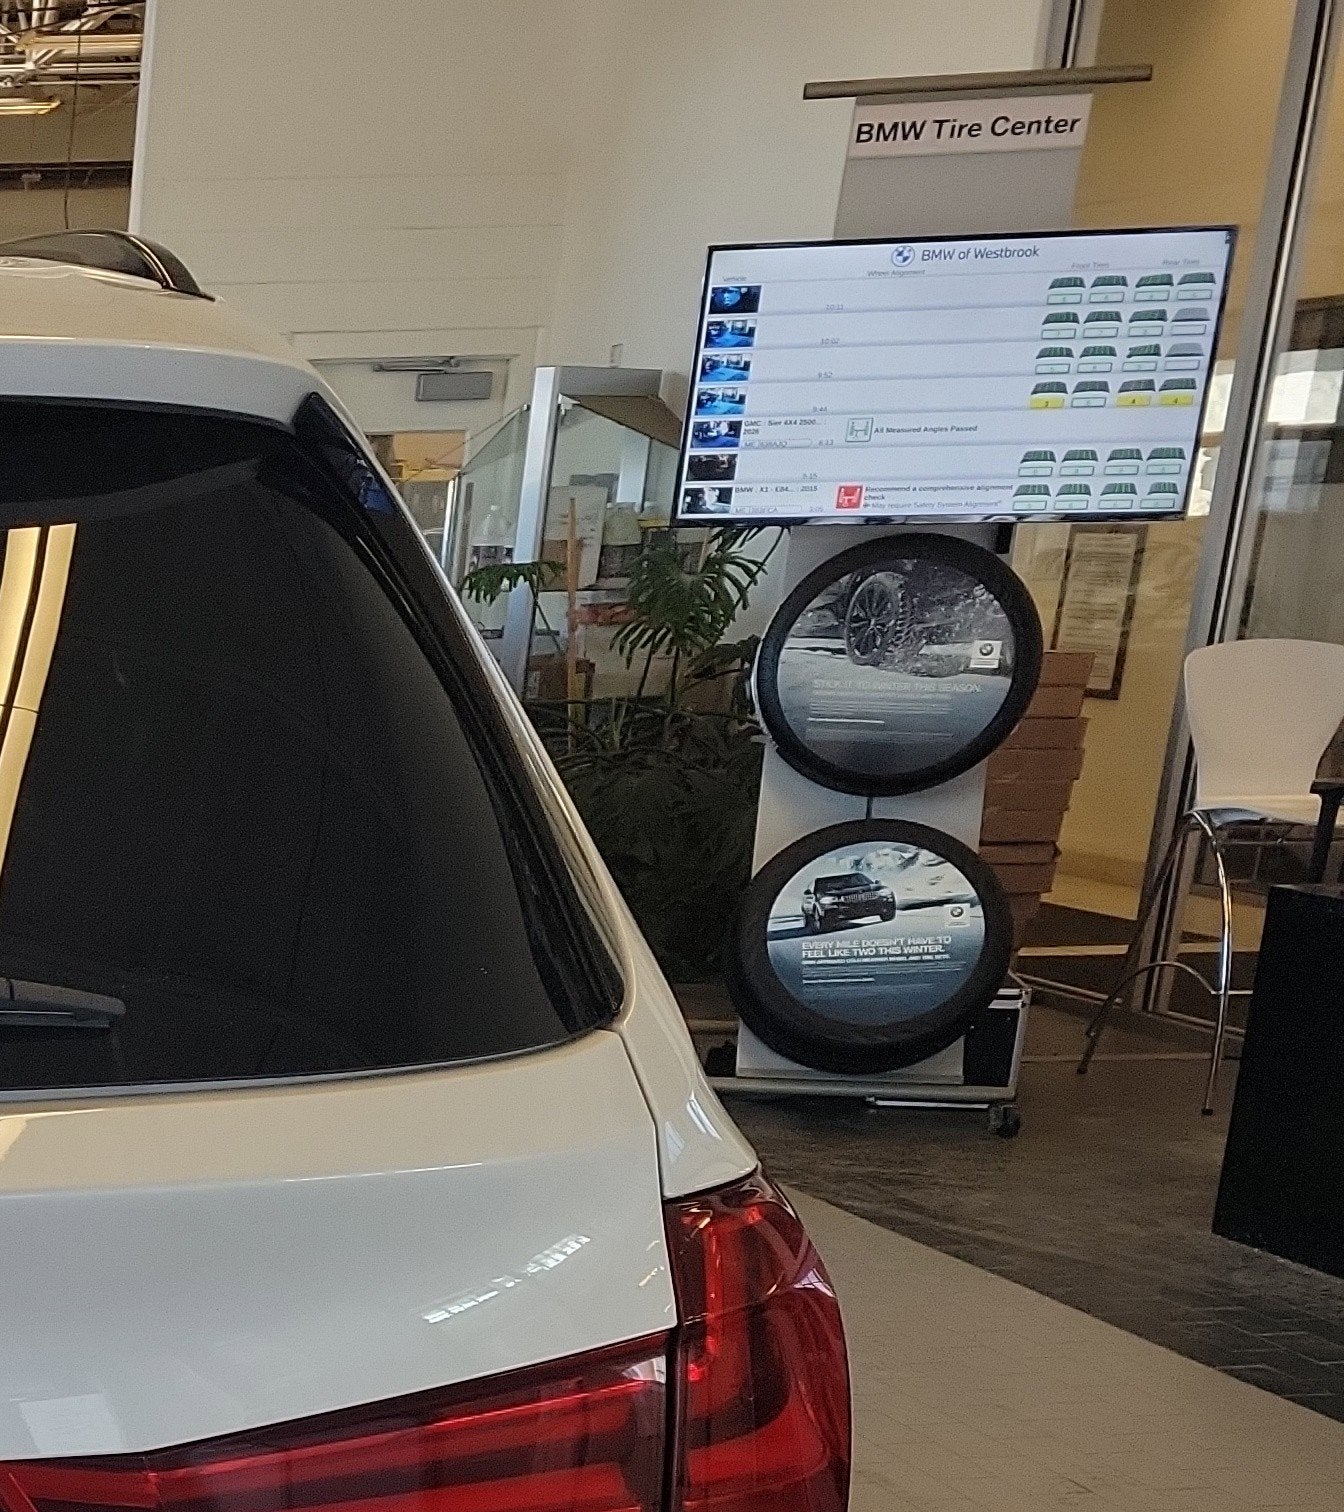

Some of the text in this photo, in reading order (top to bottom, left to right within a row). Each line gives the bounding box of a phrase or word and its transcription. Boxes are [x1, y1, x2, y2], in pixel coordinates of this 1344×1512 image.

[855, 115, 1082, 144] BMW Tire Center
[921, 245, 1040, 262] BMW of Westbrook
[886, 426, 922, 434] Measured
[923, 425, 949, 434] Angles
[950, 425, 978, 433] Passed
[918, 484, 975, 493] comprehensive
[976, 484, 1013, 493] alignment
[802, 935, 952, 950] EVERY MILE DOESN'T HAVE TO
[802, 950, 827, 959] FEEL
[828, 949, 852, 957] LIKE
[853, 947, 876, 956] TWO
[879, 946, 902, 955] THIS
[903, 945, 946, 954] WINTER.
